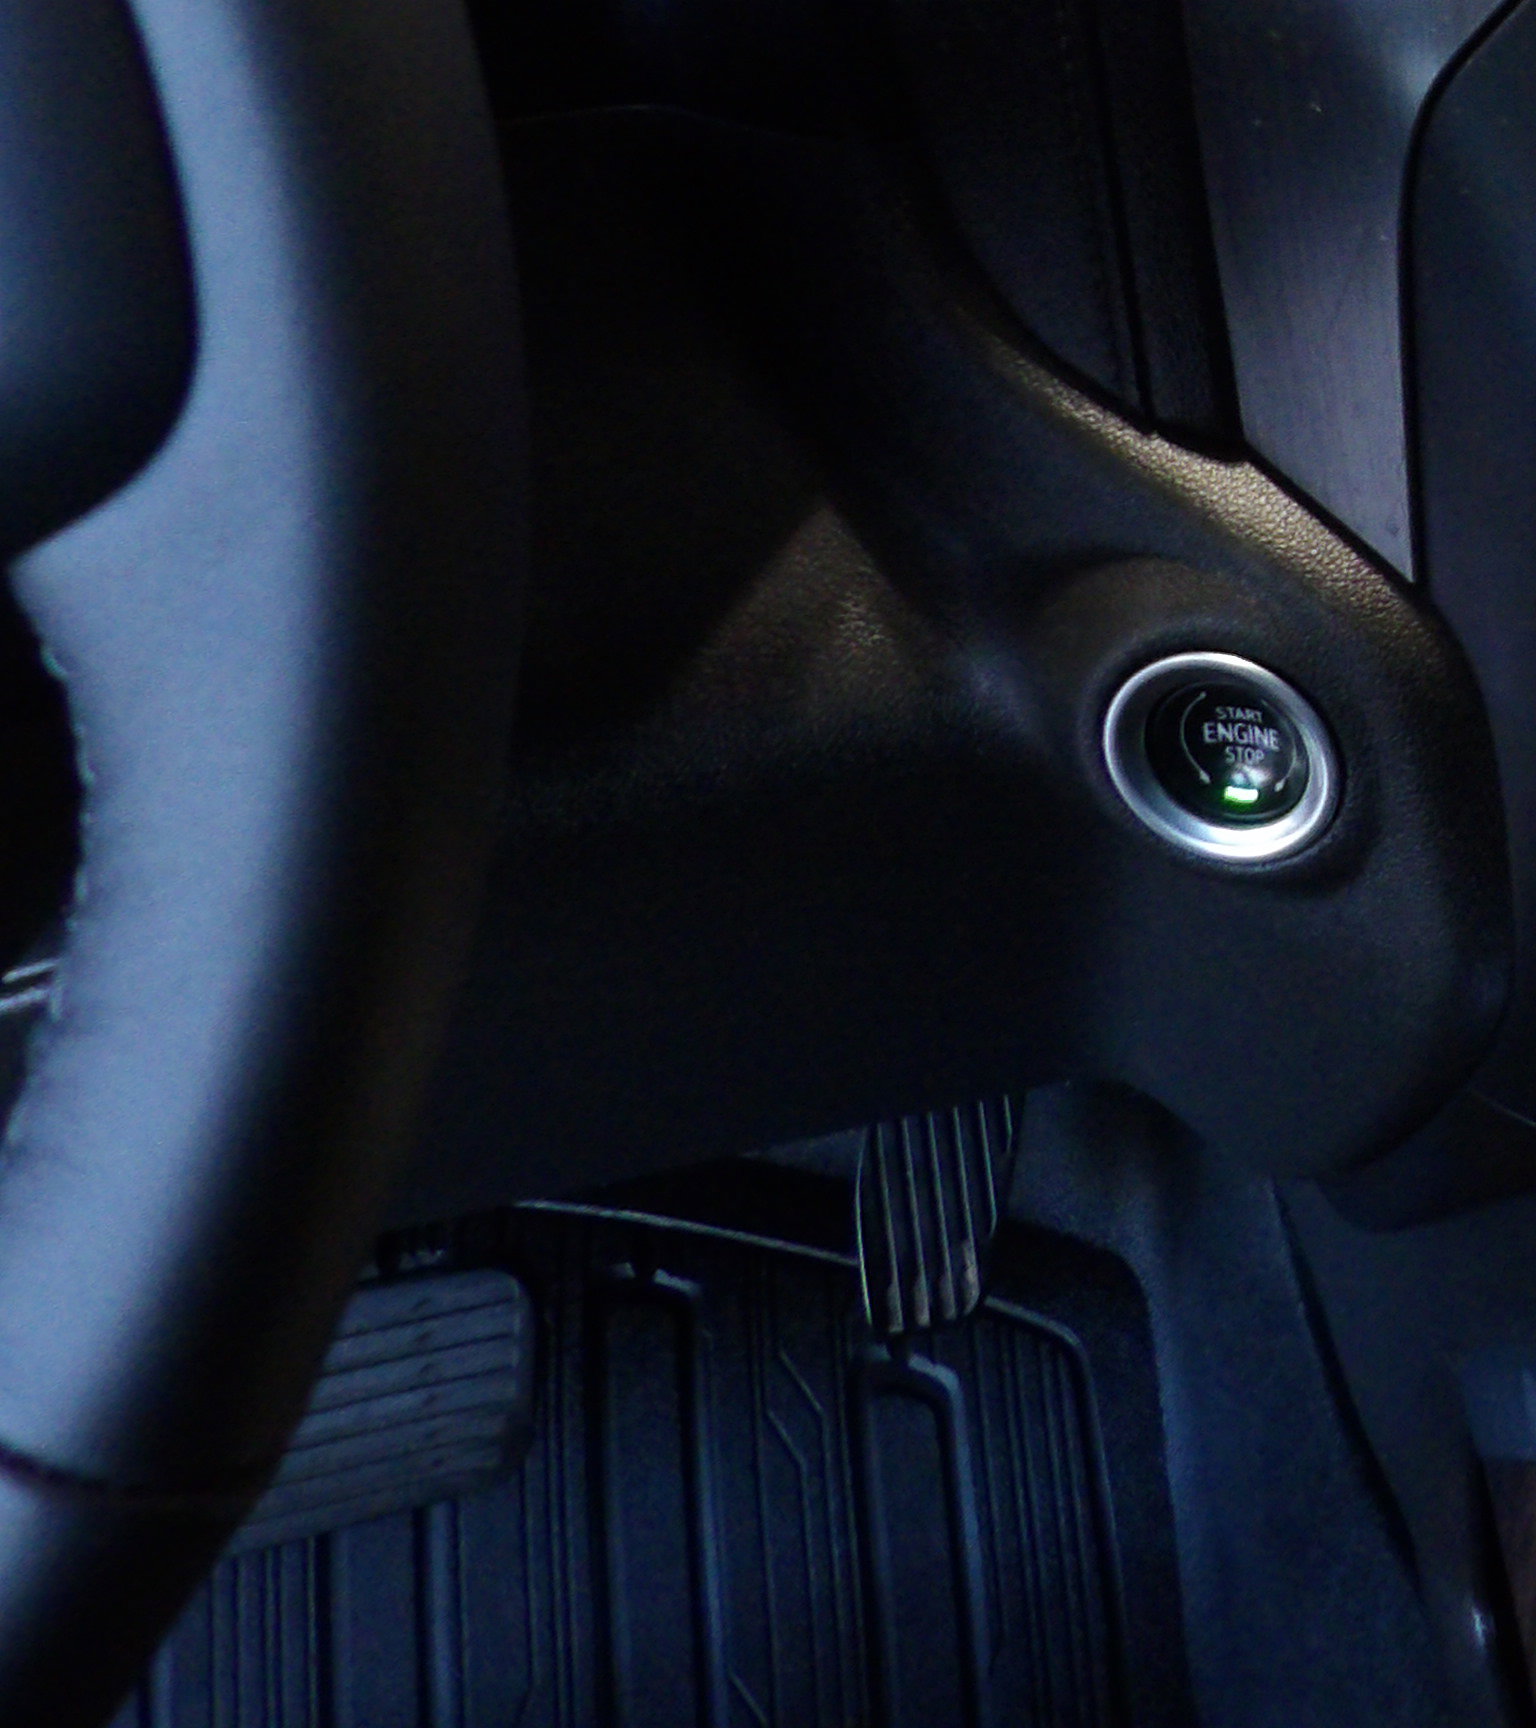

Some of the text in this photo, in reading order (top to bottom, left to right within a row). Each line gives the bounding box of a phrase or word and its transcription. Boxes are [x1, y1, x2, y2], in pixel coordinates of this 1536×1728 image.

[1216, 706, 1263, 724] START
[1203, 722, 1280, 752] ENGINE
[1224, 745, 1265, 764] STOP
